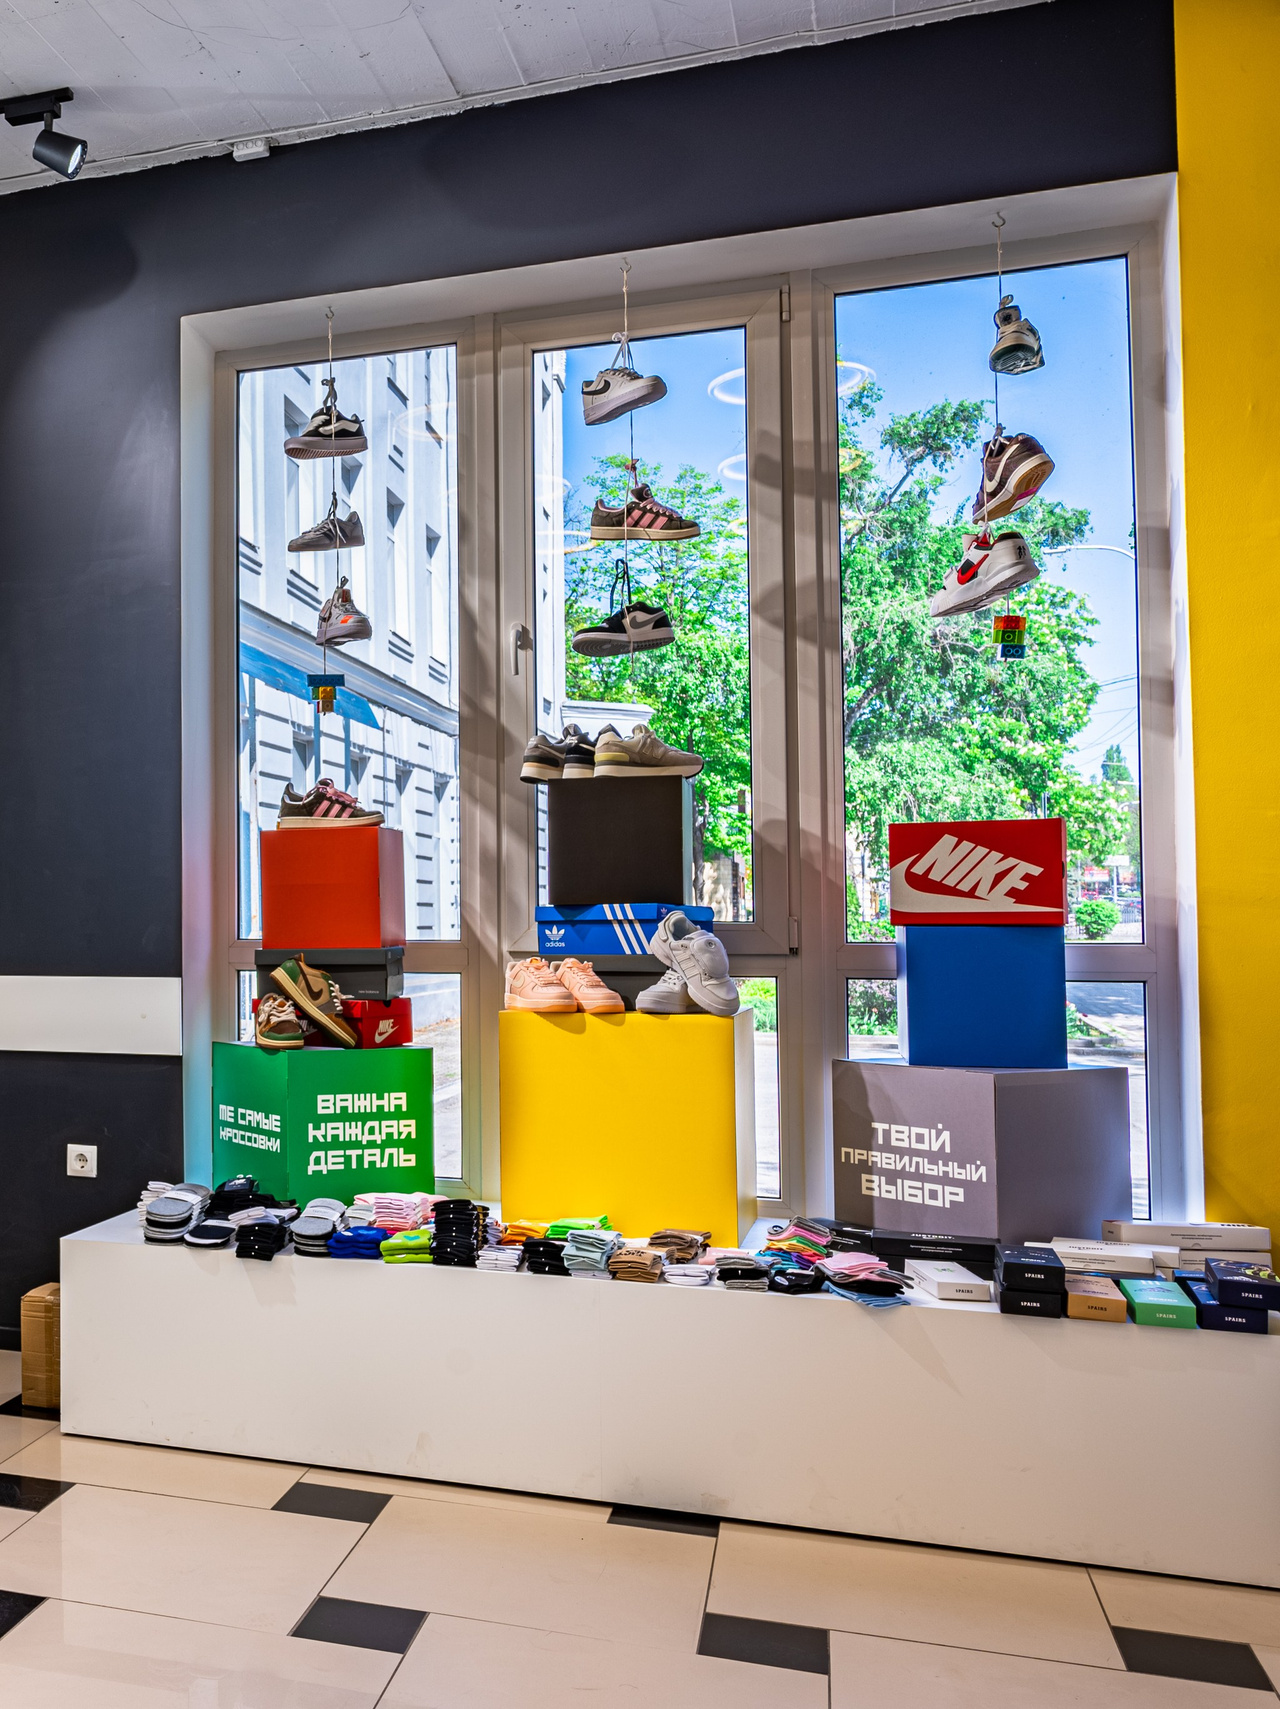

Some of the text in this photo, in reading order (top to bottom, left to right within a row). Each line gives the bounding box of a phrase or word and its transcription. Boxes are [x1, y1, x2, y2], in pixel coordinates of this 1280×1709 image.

[910, 833, 1044, 904] NIKE
[545, 939, 565, 947] adidas
[379, 1019, 394, 1033] NIKE
[317, 1092, 407, 1114] ВАЖНА
[219, 1104, 281, 1132] ТЕ САМЫЕ
[308, 1119, 416, 1144] КАЖДАЯ
[219, 1126, 281, 1153] КРОССОВКИ
[871, 1122, 951, 1153] ТВОЙ
[307, 1147, 416, 1175] ДЕТАЛЬ
[841, 1147, 987, 1183] ПРАВИЛЬНЫЙ
[861, 1173, 964, 1208] ВЫБОР
